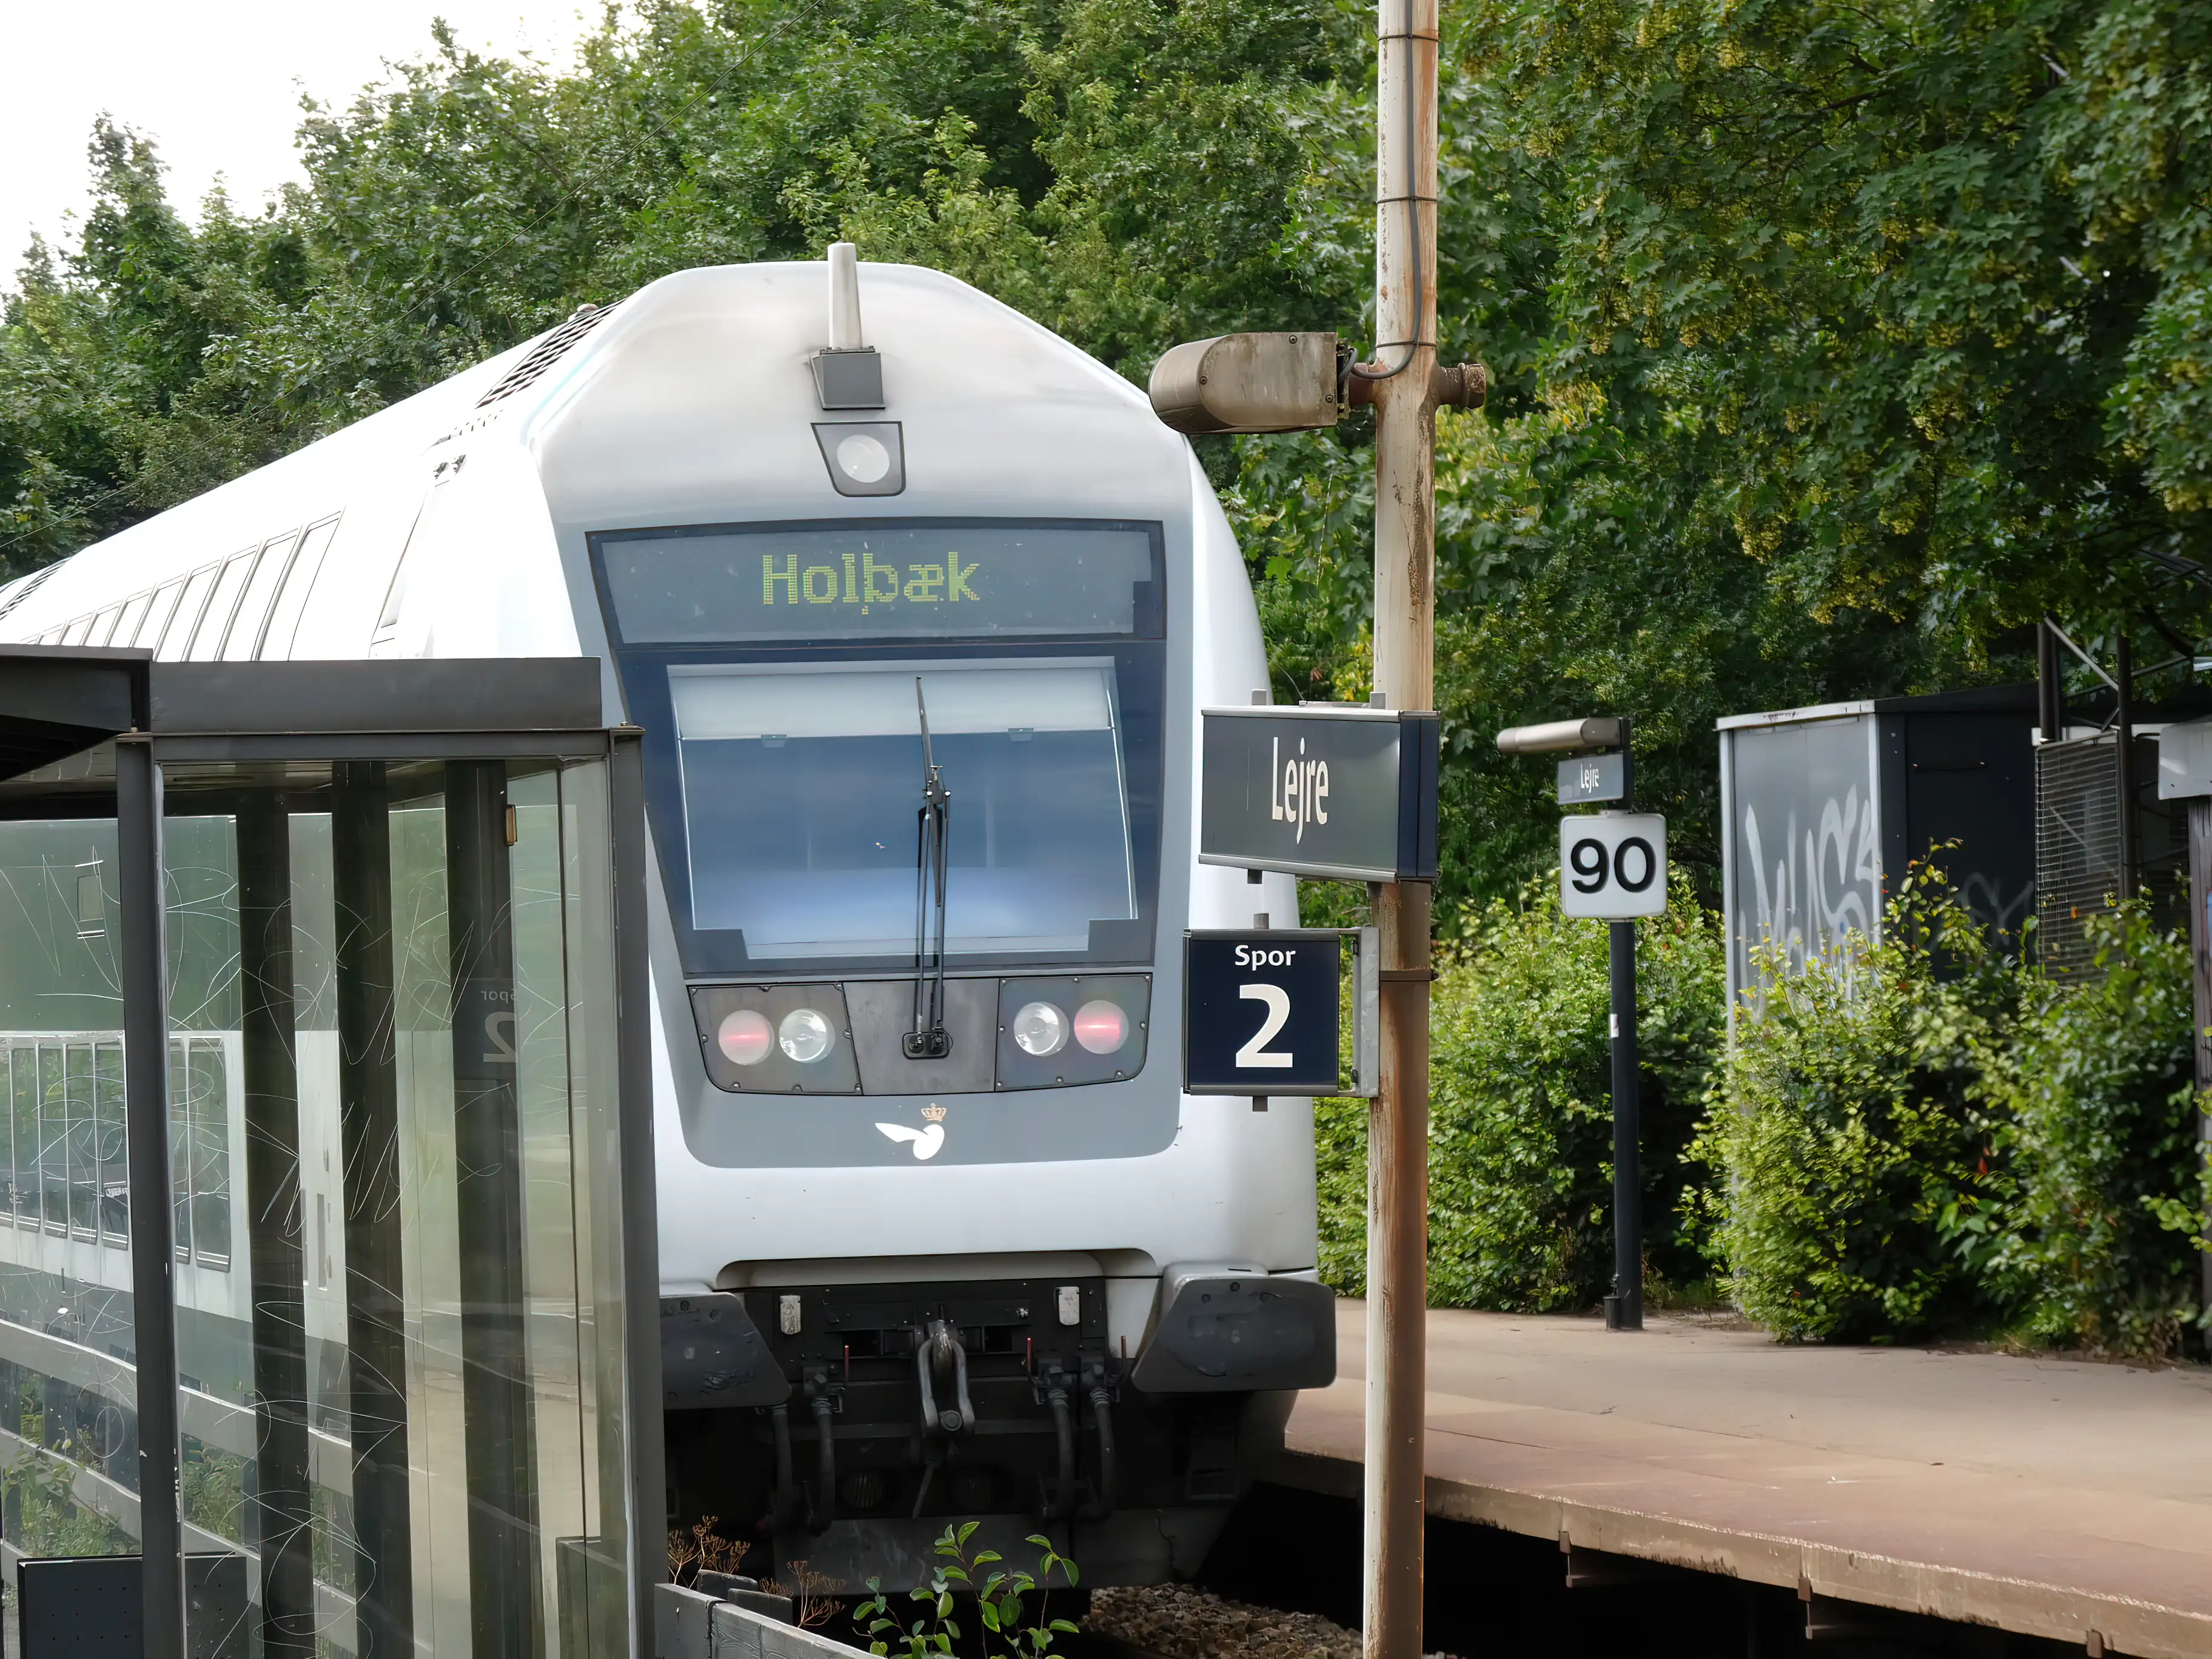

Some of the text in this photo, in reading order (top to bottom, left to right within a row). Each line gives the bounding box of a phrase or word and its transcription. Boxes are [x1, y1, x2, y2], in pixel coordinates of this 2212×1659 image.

[763, 551, 980, 605] Holbæk
[1272, 737, 1329, 844] Lejre
[1581, 763, 1599, 793] Lejre
[1570, 837, 1657, 894] 90
[1235, 945, 1296, 971] Spor
[1235, 984, 1293, 1068] 2
